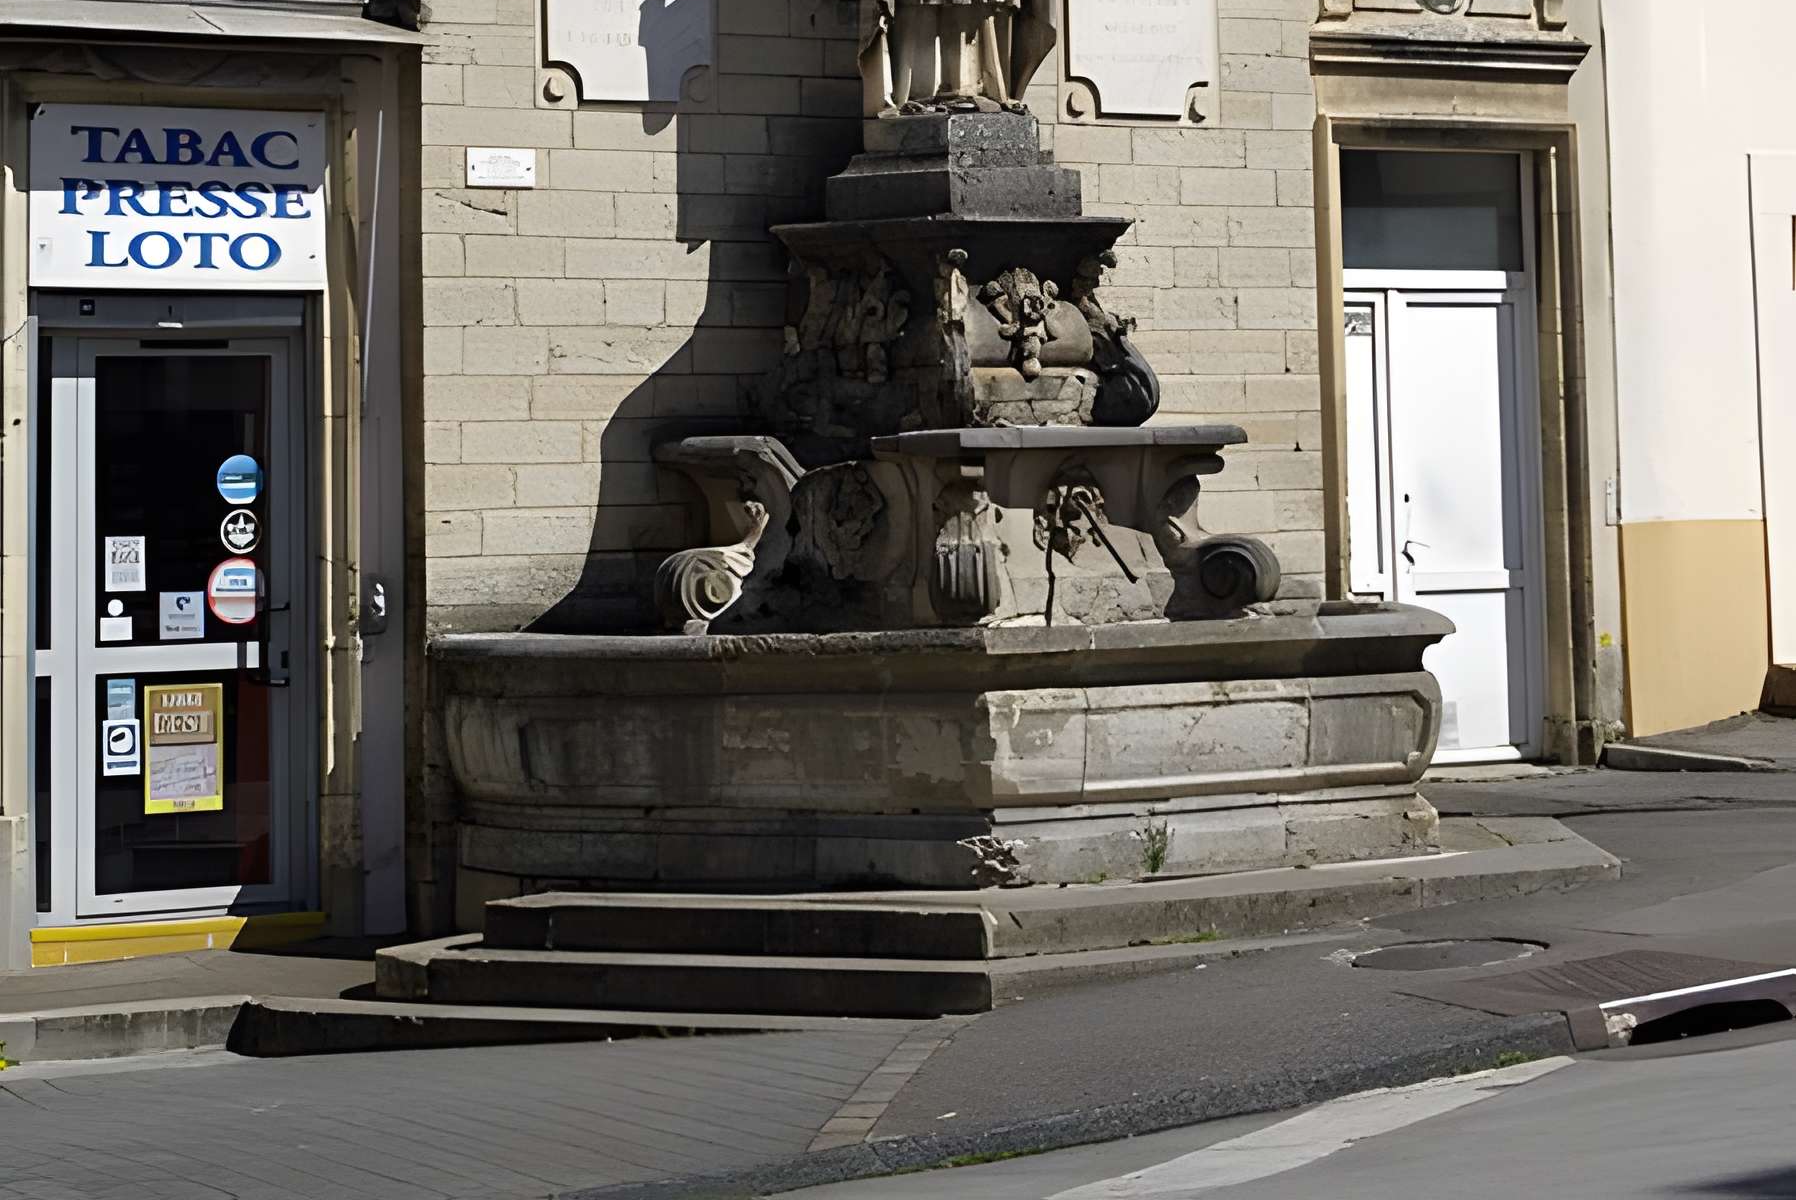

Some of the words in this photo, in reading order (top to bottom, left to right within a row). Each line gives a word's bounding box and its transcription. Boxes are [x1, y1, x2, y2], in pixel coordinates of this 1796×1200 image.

[71, 126, 299, 169] TABAC
[58, 177, 312, 219] PRESSE
[85, 230, 282, 270] LOTO
